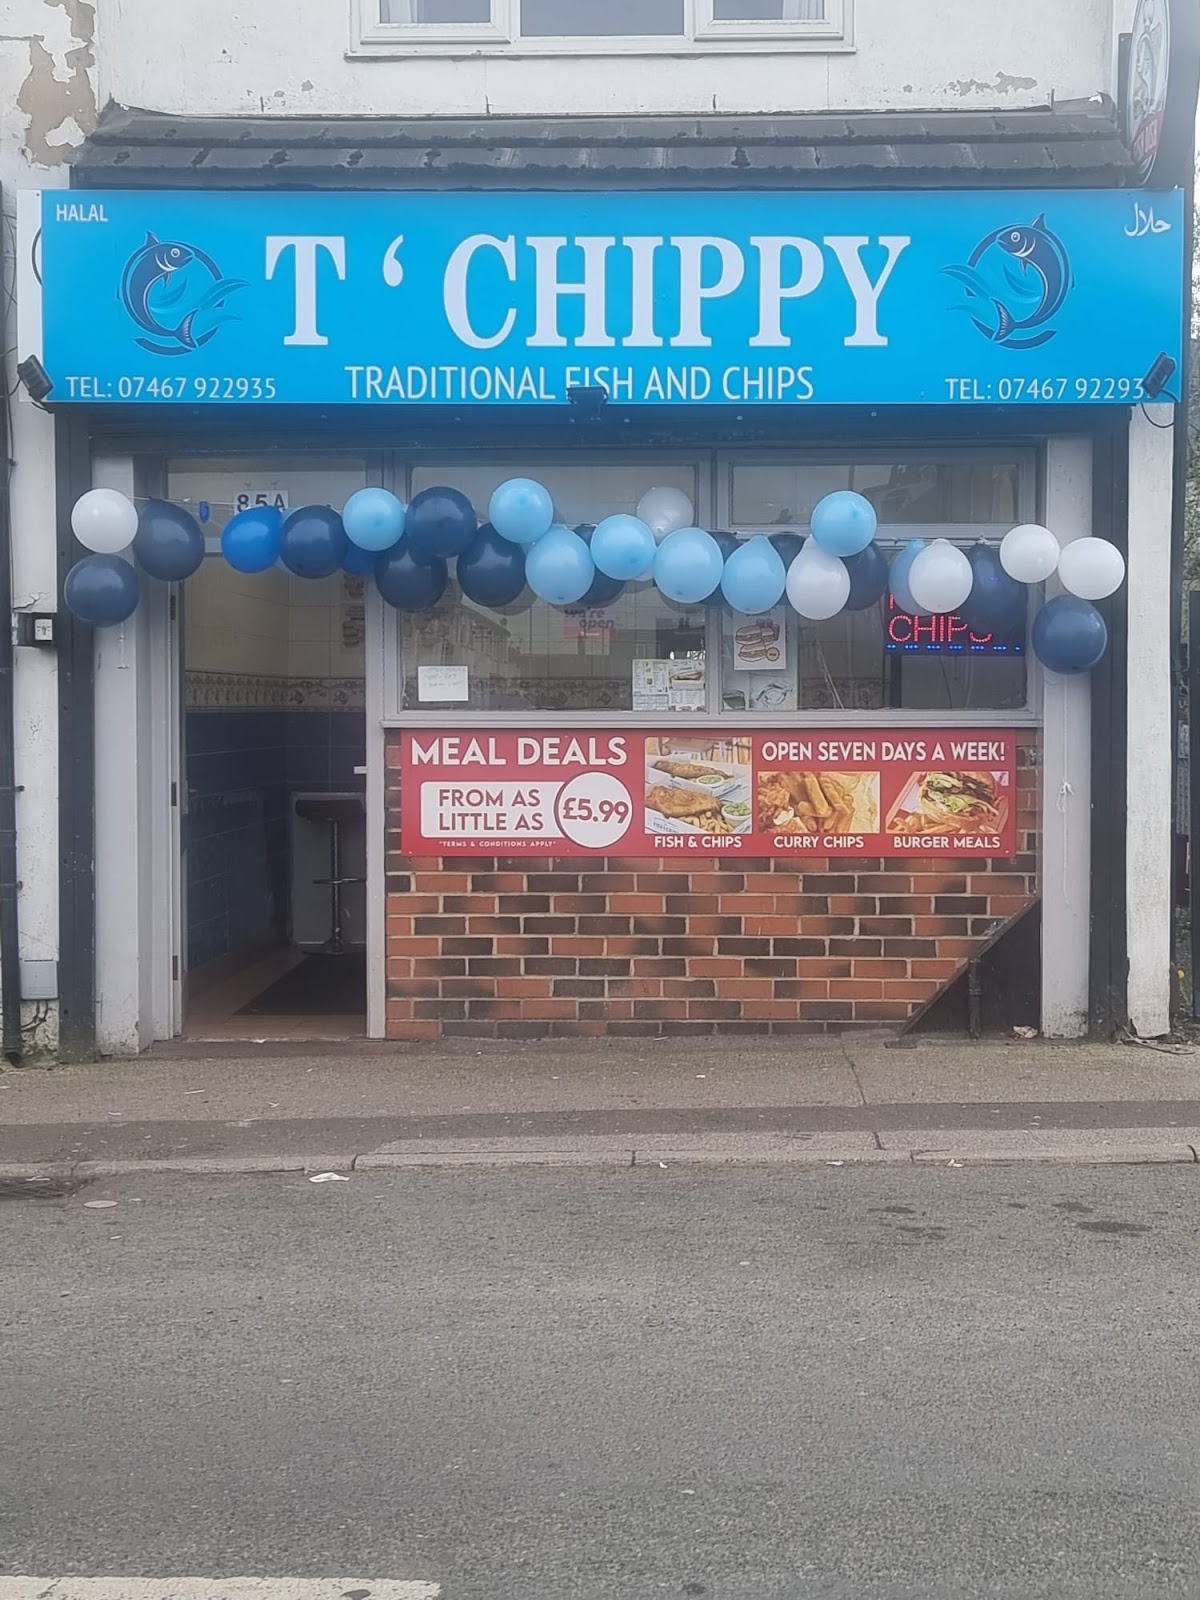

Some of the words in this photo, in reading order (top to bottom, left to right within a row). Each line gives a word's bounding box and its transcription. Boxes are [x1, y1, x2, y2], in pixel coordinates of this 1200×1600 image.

[56, 204, 108, 222] HALAL
[1124, 202, 1172, 237] حلال
[265, 236, 346, 346] T
[443, 234, 911, 349] CHIPPY
[65, 377, 112, 398] TEL:
[118, 377, 187, 398] 07467
[194, 377, 276, 398] 922935
[344, 366, 556, 399] TRADITIONAL
[565, 366, 633, 399] FISH
[644, 366, 711, 399] AND
[722, 366, 814, 400] CHIPS
[945, 379, 991, 399] TEL:
[998, 379, 1067, 399] 07467
[1076, 379, 1151, 399] 92293
[237, 493, 286, 512] 85A
[411, 737, 507, 766] MEAL
[517, 737, 627, 766] DEALS
[762, 741, 812, 761] OPEN
[818, 741, 876, 761] SEVEN
[881, 741, 927, 761] DAYS
[932, 742, 946, 761] A
[950, 741, 1006, 761] WEEK!
[439, 789, 503, 807] FROM
[511, 789, 540, 807] AS
[562, 797, 630, 824] £5.99
[439, 812, 507, 831] LITTLE
[514, 812, 544, 831] AS
[654, 835, 684, 848] FISH
[687, 835, 698, 848] &
[702, 835, 742, 848] CHIPS
[773, 835, 820, 848] CURRY
[823, 835, 865, 848] CHIPS
[893, 836, 950, 849] BURGER
[953, 836, 1001, 849] MEALS
